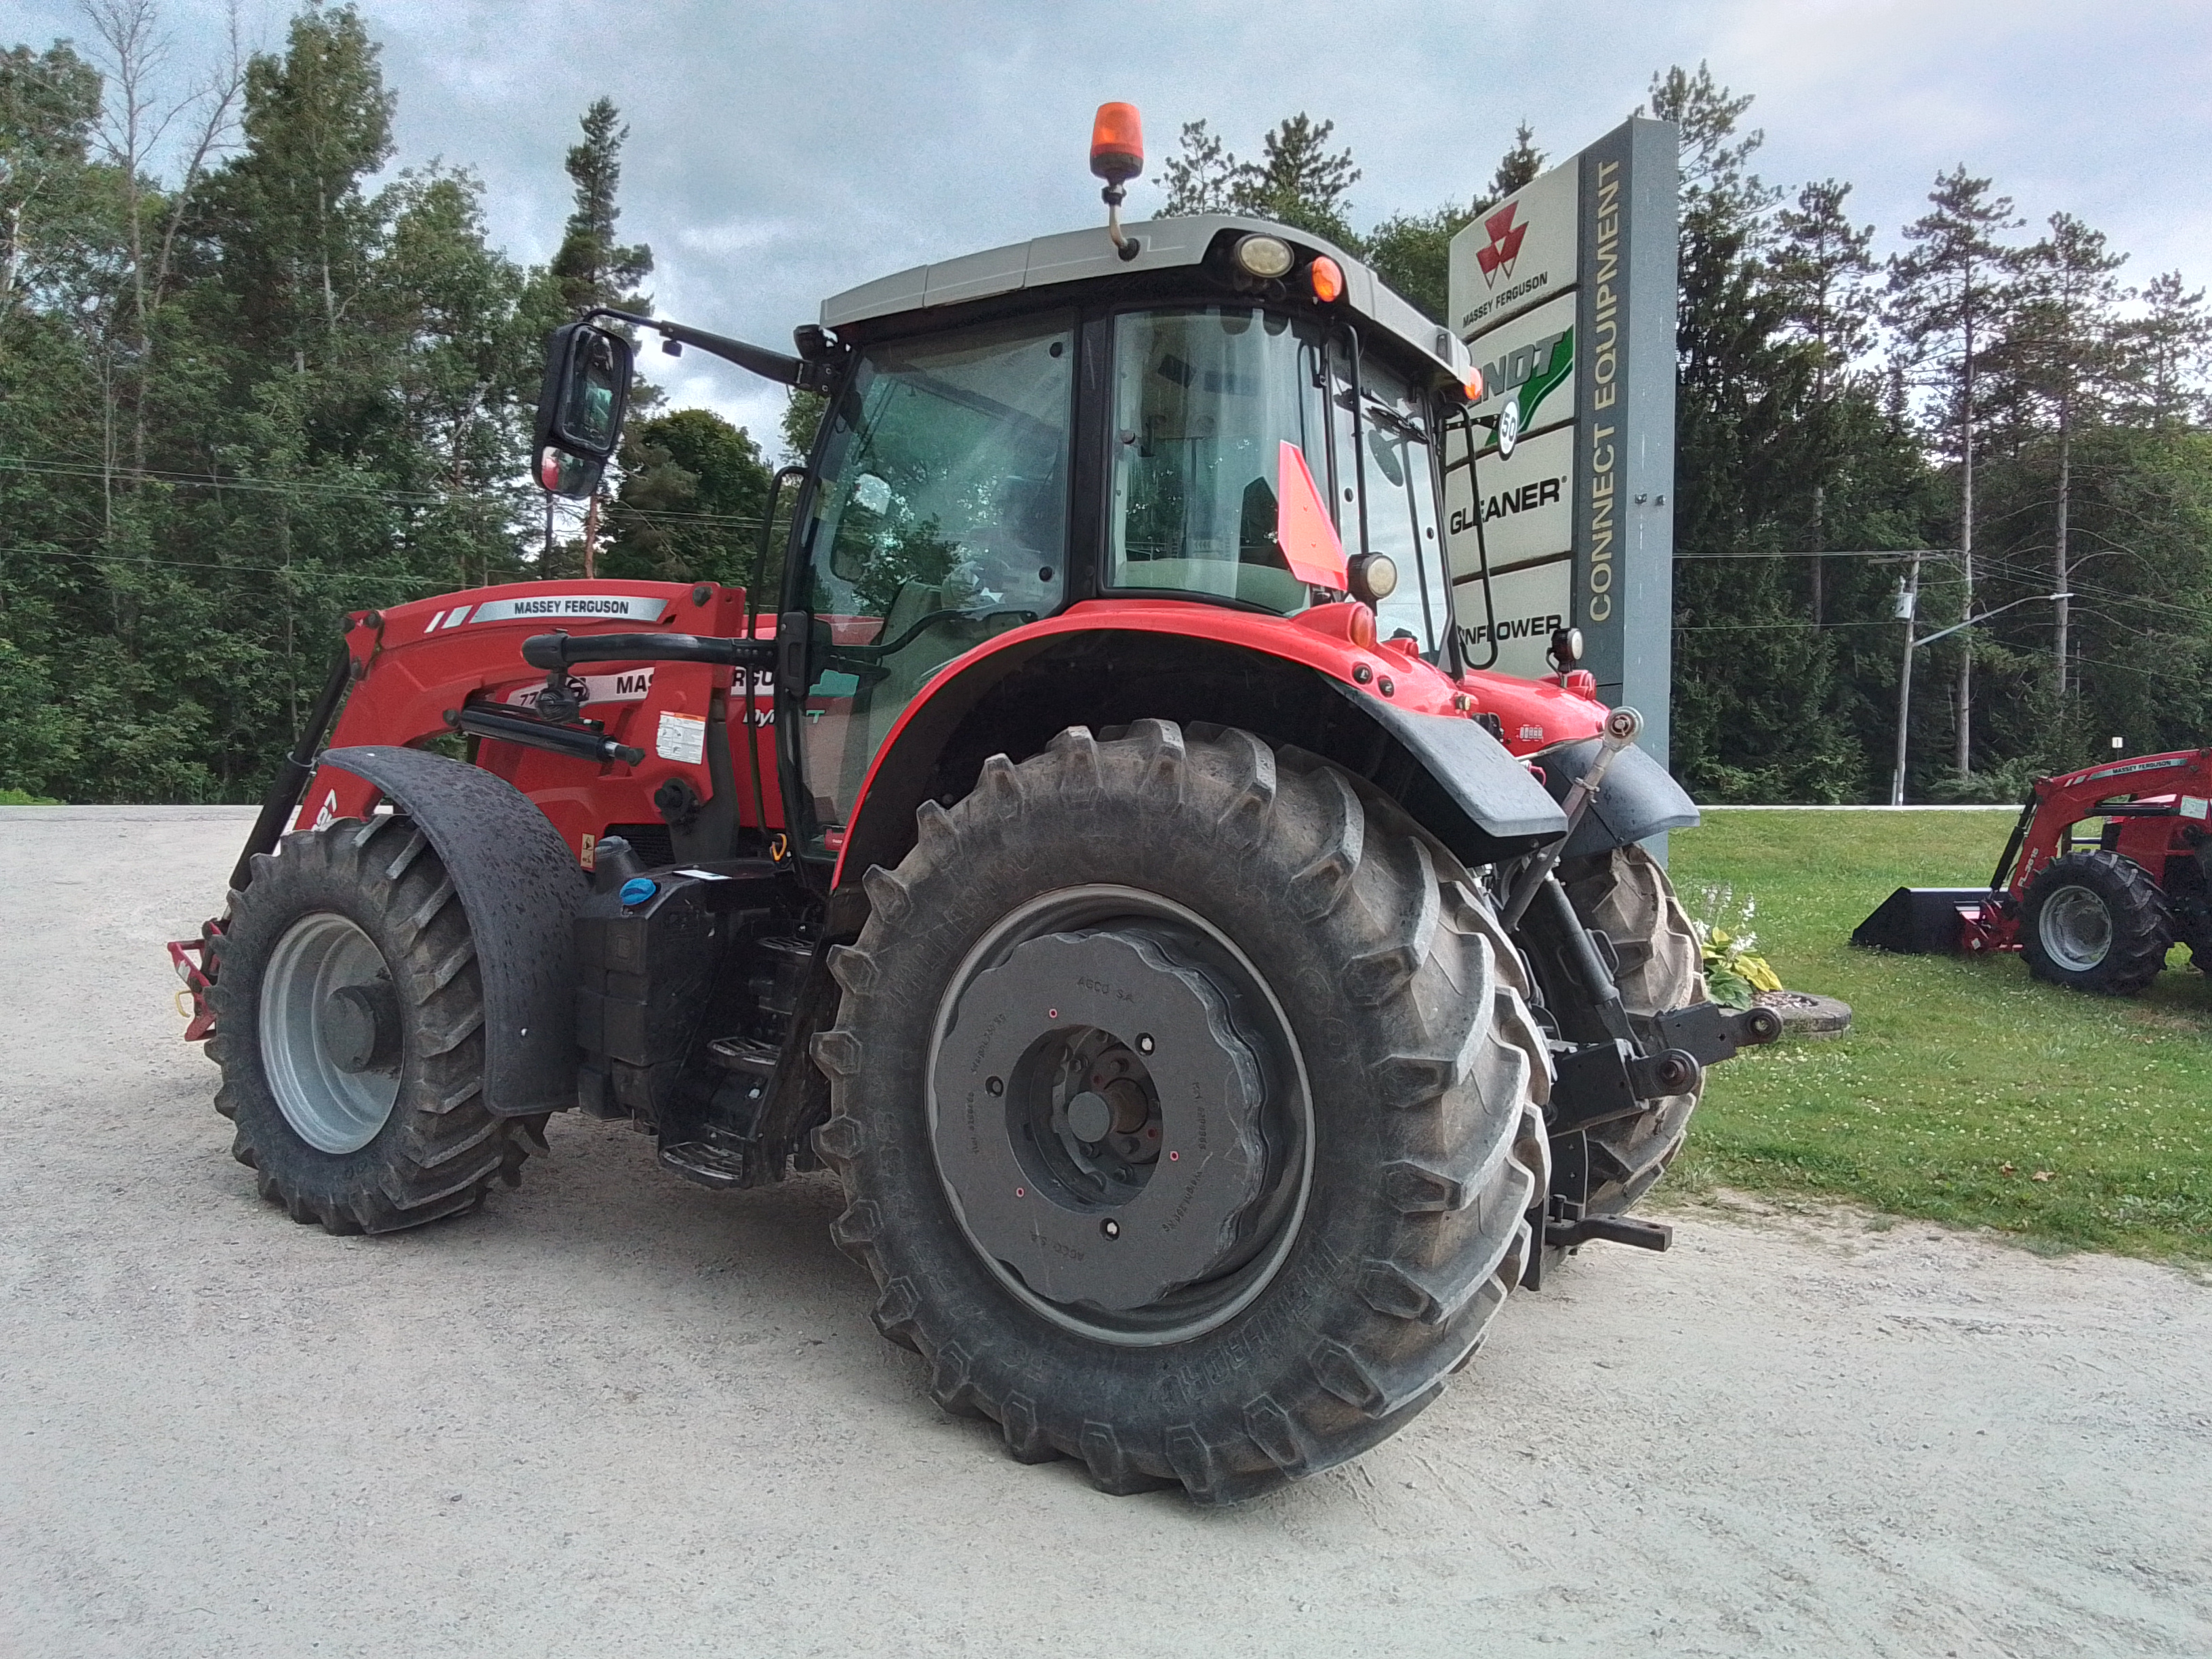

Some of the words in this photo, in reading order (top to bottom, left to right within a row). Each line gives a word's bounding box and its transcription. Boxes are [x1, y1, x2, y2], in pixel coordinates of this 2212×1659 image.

[1462, 299, 1493, 329] MASSEY
[1496, 271, 1548, 309] FERGUSON
[1595, 160, 1619, 411] EQUIPMENT
[1469, 331, 1565, 409] NDT
[1501, 411, 1516, 442] 50
[1590, 423, 1616, 621] CONNECT
[514, 600, 561, 614] MASSEY
[565, 600, 629, 614] FERGUSON
[1460, 614, 1561, 645] NFLOWER
[2112, 766, 2137, 774] MASSEY
[2138, 760, 2171, 770] FERGUSON
